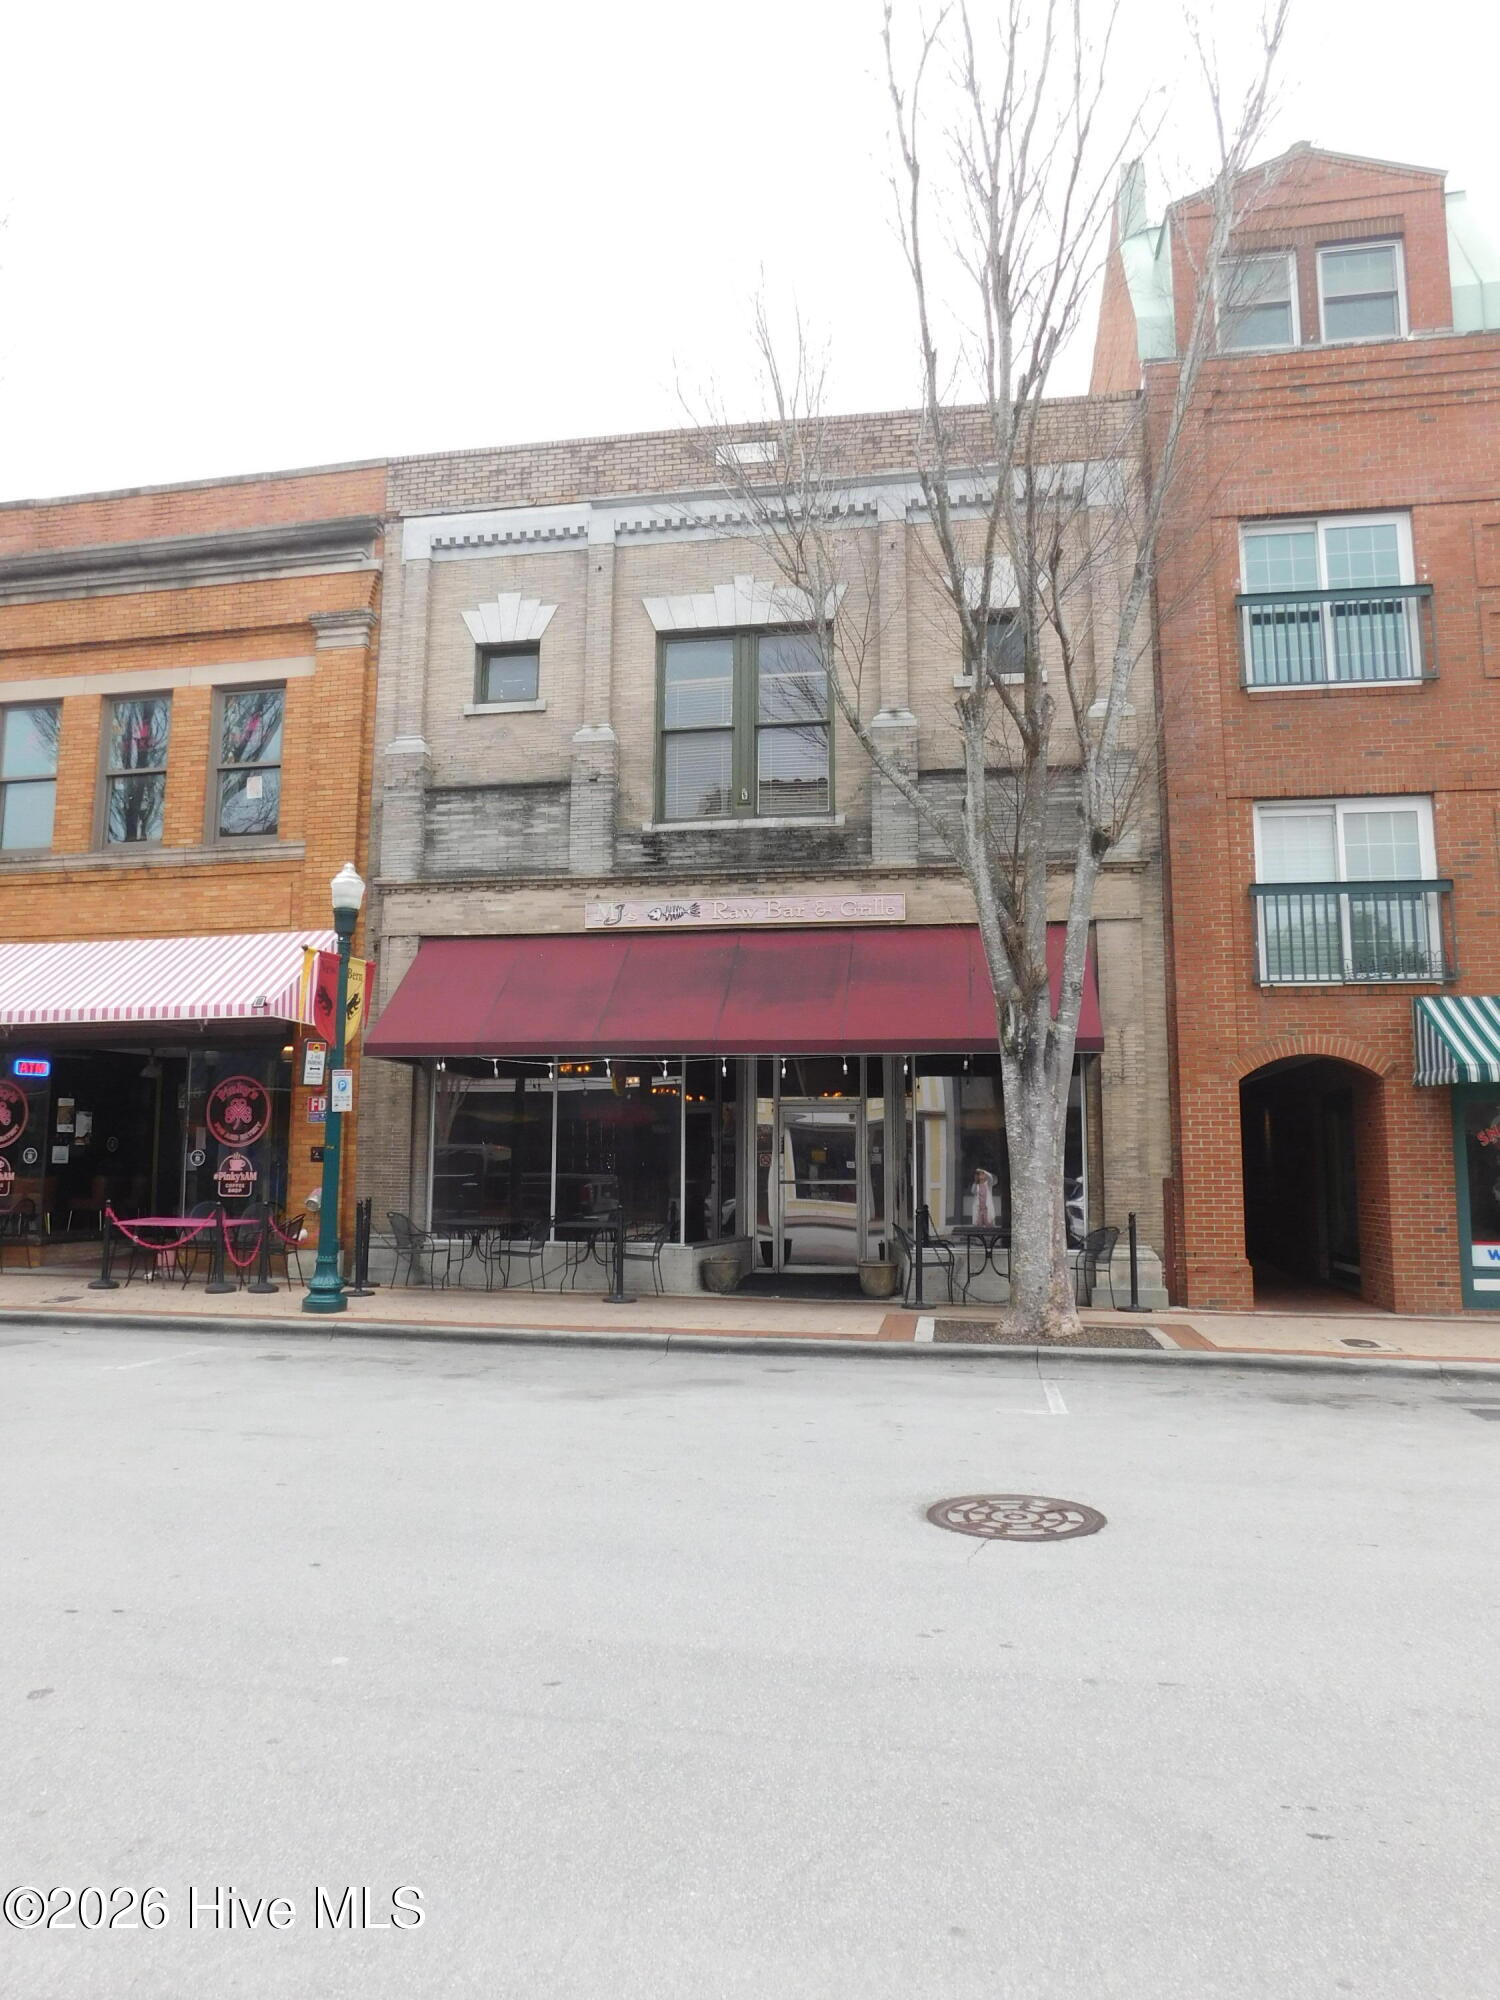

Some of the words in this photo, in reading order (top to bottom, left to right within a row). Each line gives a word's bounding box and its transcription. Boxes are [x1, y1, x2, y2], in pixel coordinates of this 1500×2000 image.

[711, 901, 758, 920] Raw
[764, 900, 805, 919] Bar
[815, 900, 832, 917] &
[840, 897, 896, 917] Grille
[19, 1062, 47, 1074] ATM
